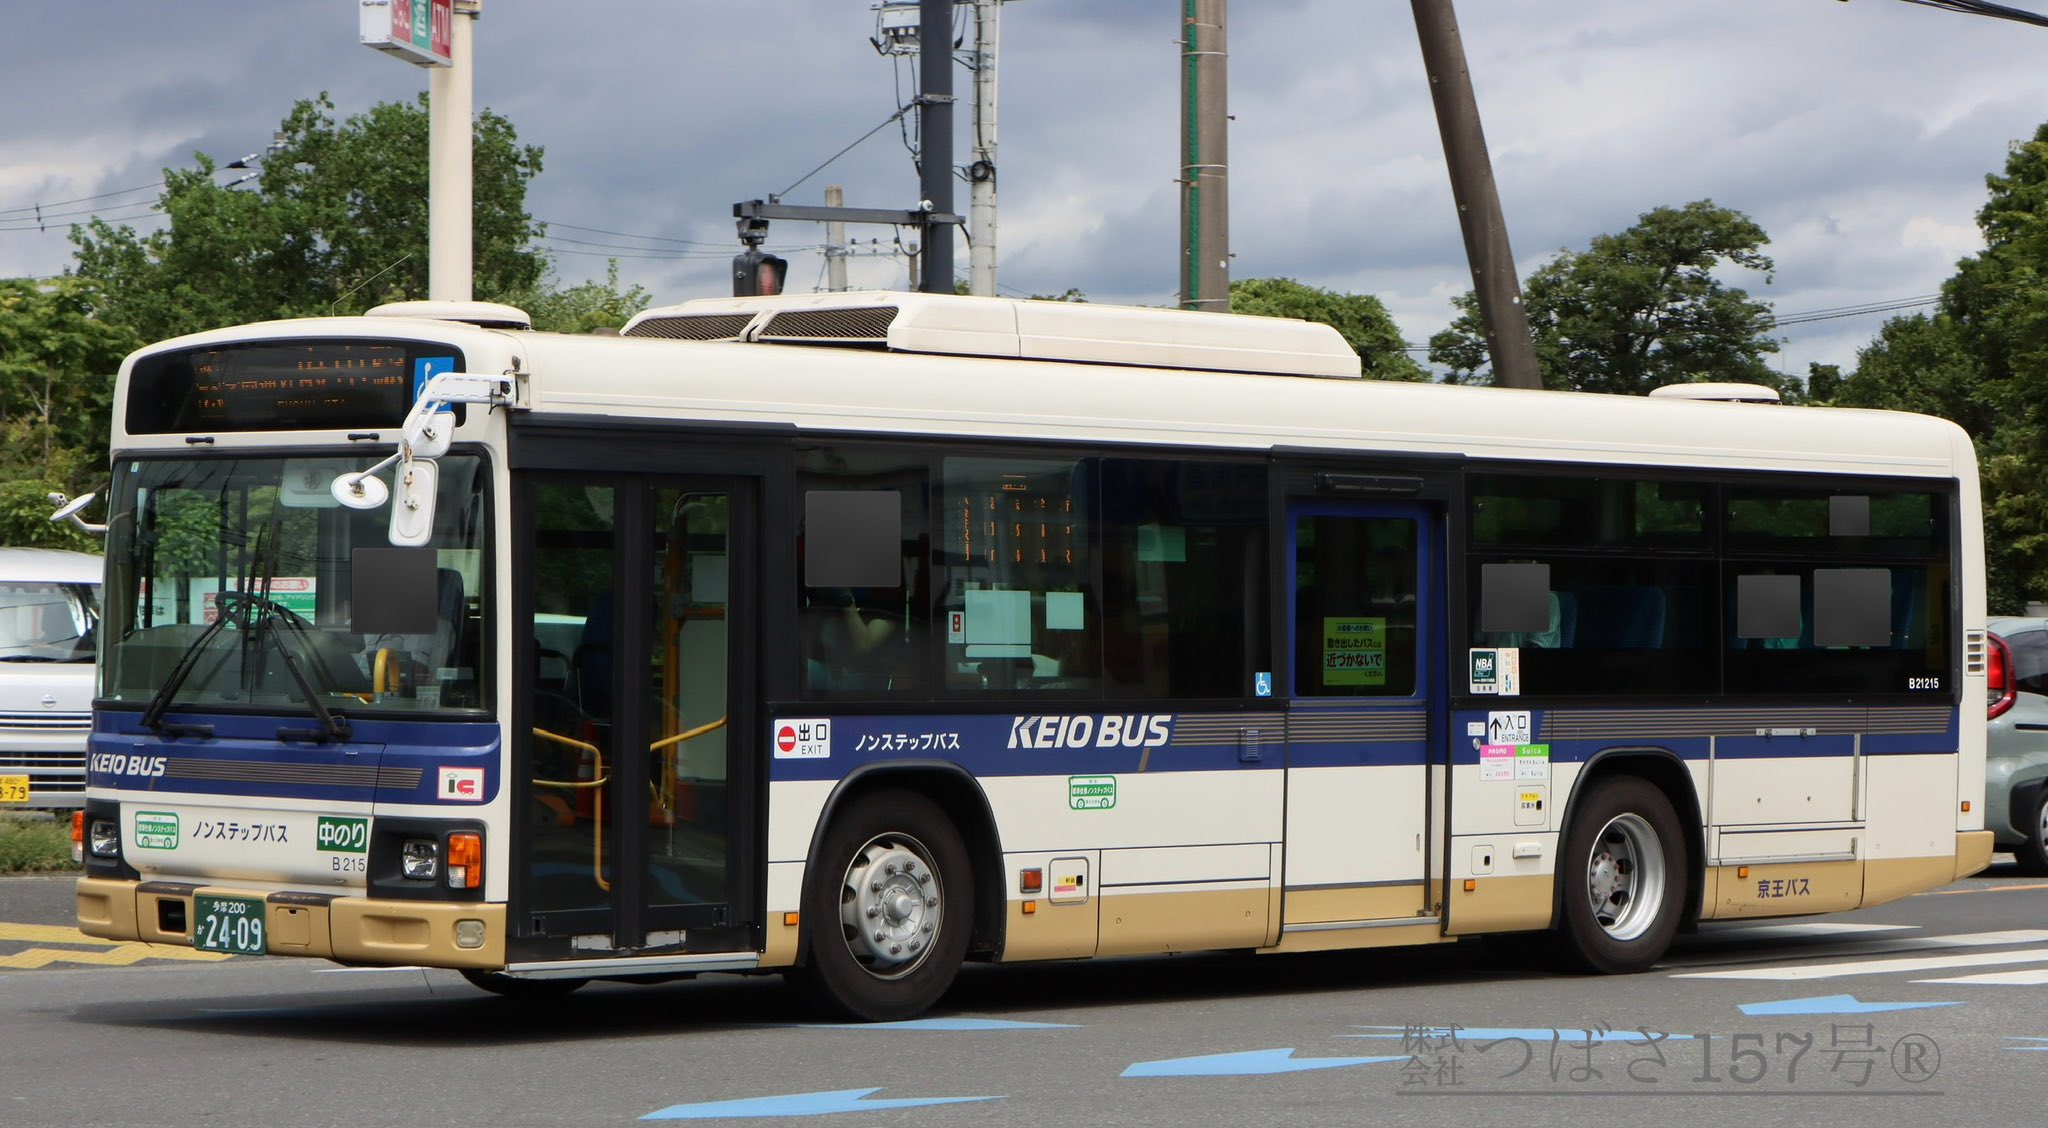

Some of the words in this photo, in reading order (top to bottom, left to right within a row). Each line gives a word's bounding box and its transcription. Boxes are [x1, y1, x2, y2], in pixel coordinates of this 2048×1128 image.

[431, 1, 450, 47] ATM
[1327, 637, 1382, 648] 動き出したバスには
[1327, 652, 1382, 668] 近づかないで
[1475, 658, 1493, 669] NBA
[1908, 677, 1939, 689] B21215
[1007, 715, 1094, 749] KEIO
[1095, 715, 1172, 748] BUS
[1505, 715, 1527, 730] 入口
[799, 723, 827, 742] 出口
[854, 732, 961, 751] ノンステップバス
[1501, 733, 1529, 742] ENTRANCE
[801, 744, 823, 755] EXIT
[90, 753, 127, 775] KEIO
[126, 755, 167, 777] BUS
[192, 821, 288, 843] ノンステップバス
[318, 821, 365, 848] 中のり
[1757, 878, 1810, 899] 京王バス
[206, 914, 262, 951] 24-09
